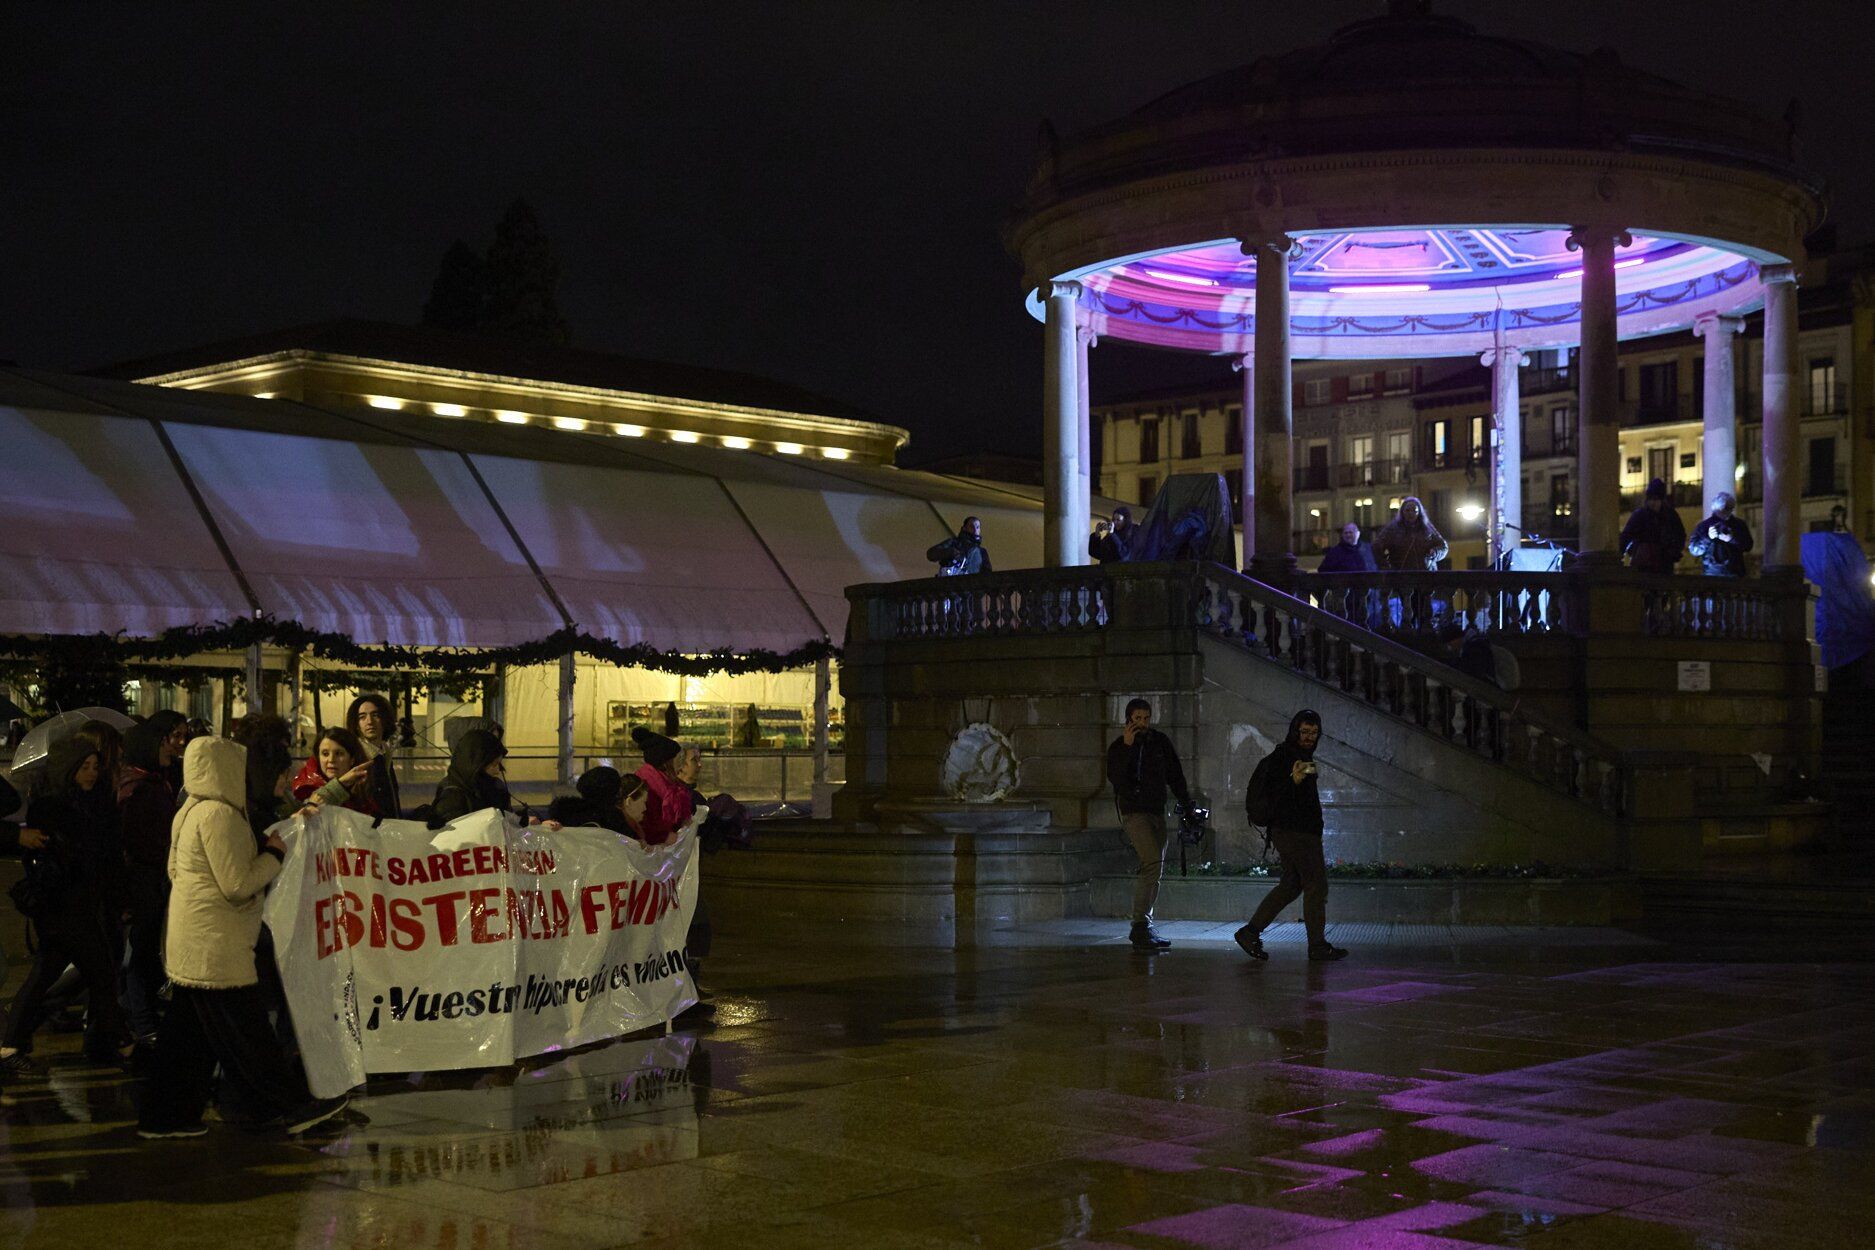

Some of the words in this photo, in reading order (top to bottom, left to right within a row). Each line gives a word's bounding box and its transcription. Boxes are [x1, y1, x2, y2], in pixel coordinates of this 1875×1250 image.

[388, 846, 509, 885] SAREEN
[367, 982, 521, 1031] ¡Vuestr
[611, 963, 630, 990] es
